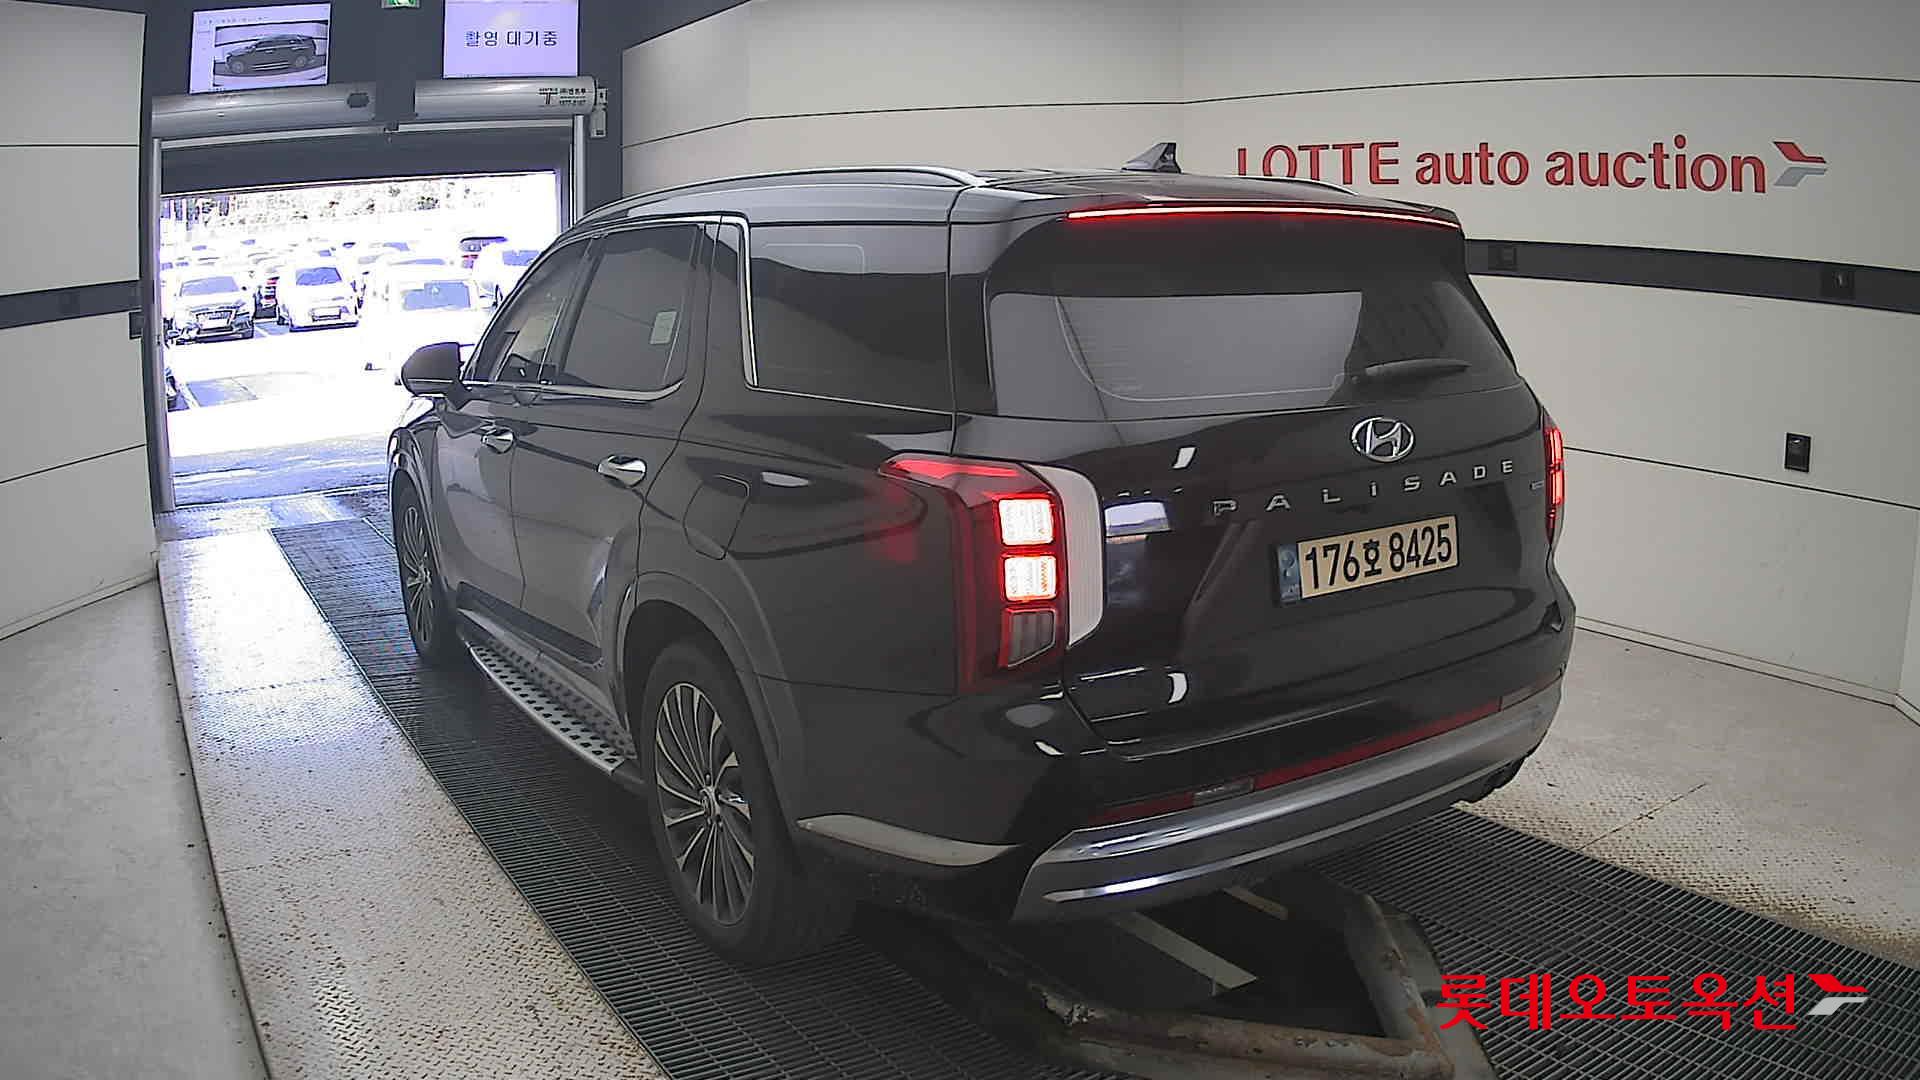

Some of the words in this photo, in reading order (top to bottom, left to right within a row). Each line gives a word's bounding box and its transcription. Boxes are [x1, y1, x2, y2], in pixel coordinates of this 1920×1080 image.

[506, 30, 558, 47] 대기중
[1415, 142, 1530, 186] auto
[1545, 134, 1767, 193] auction
[1212, 459, 1513, 516] PALISADE
